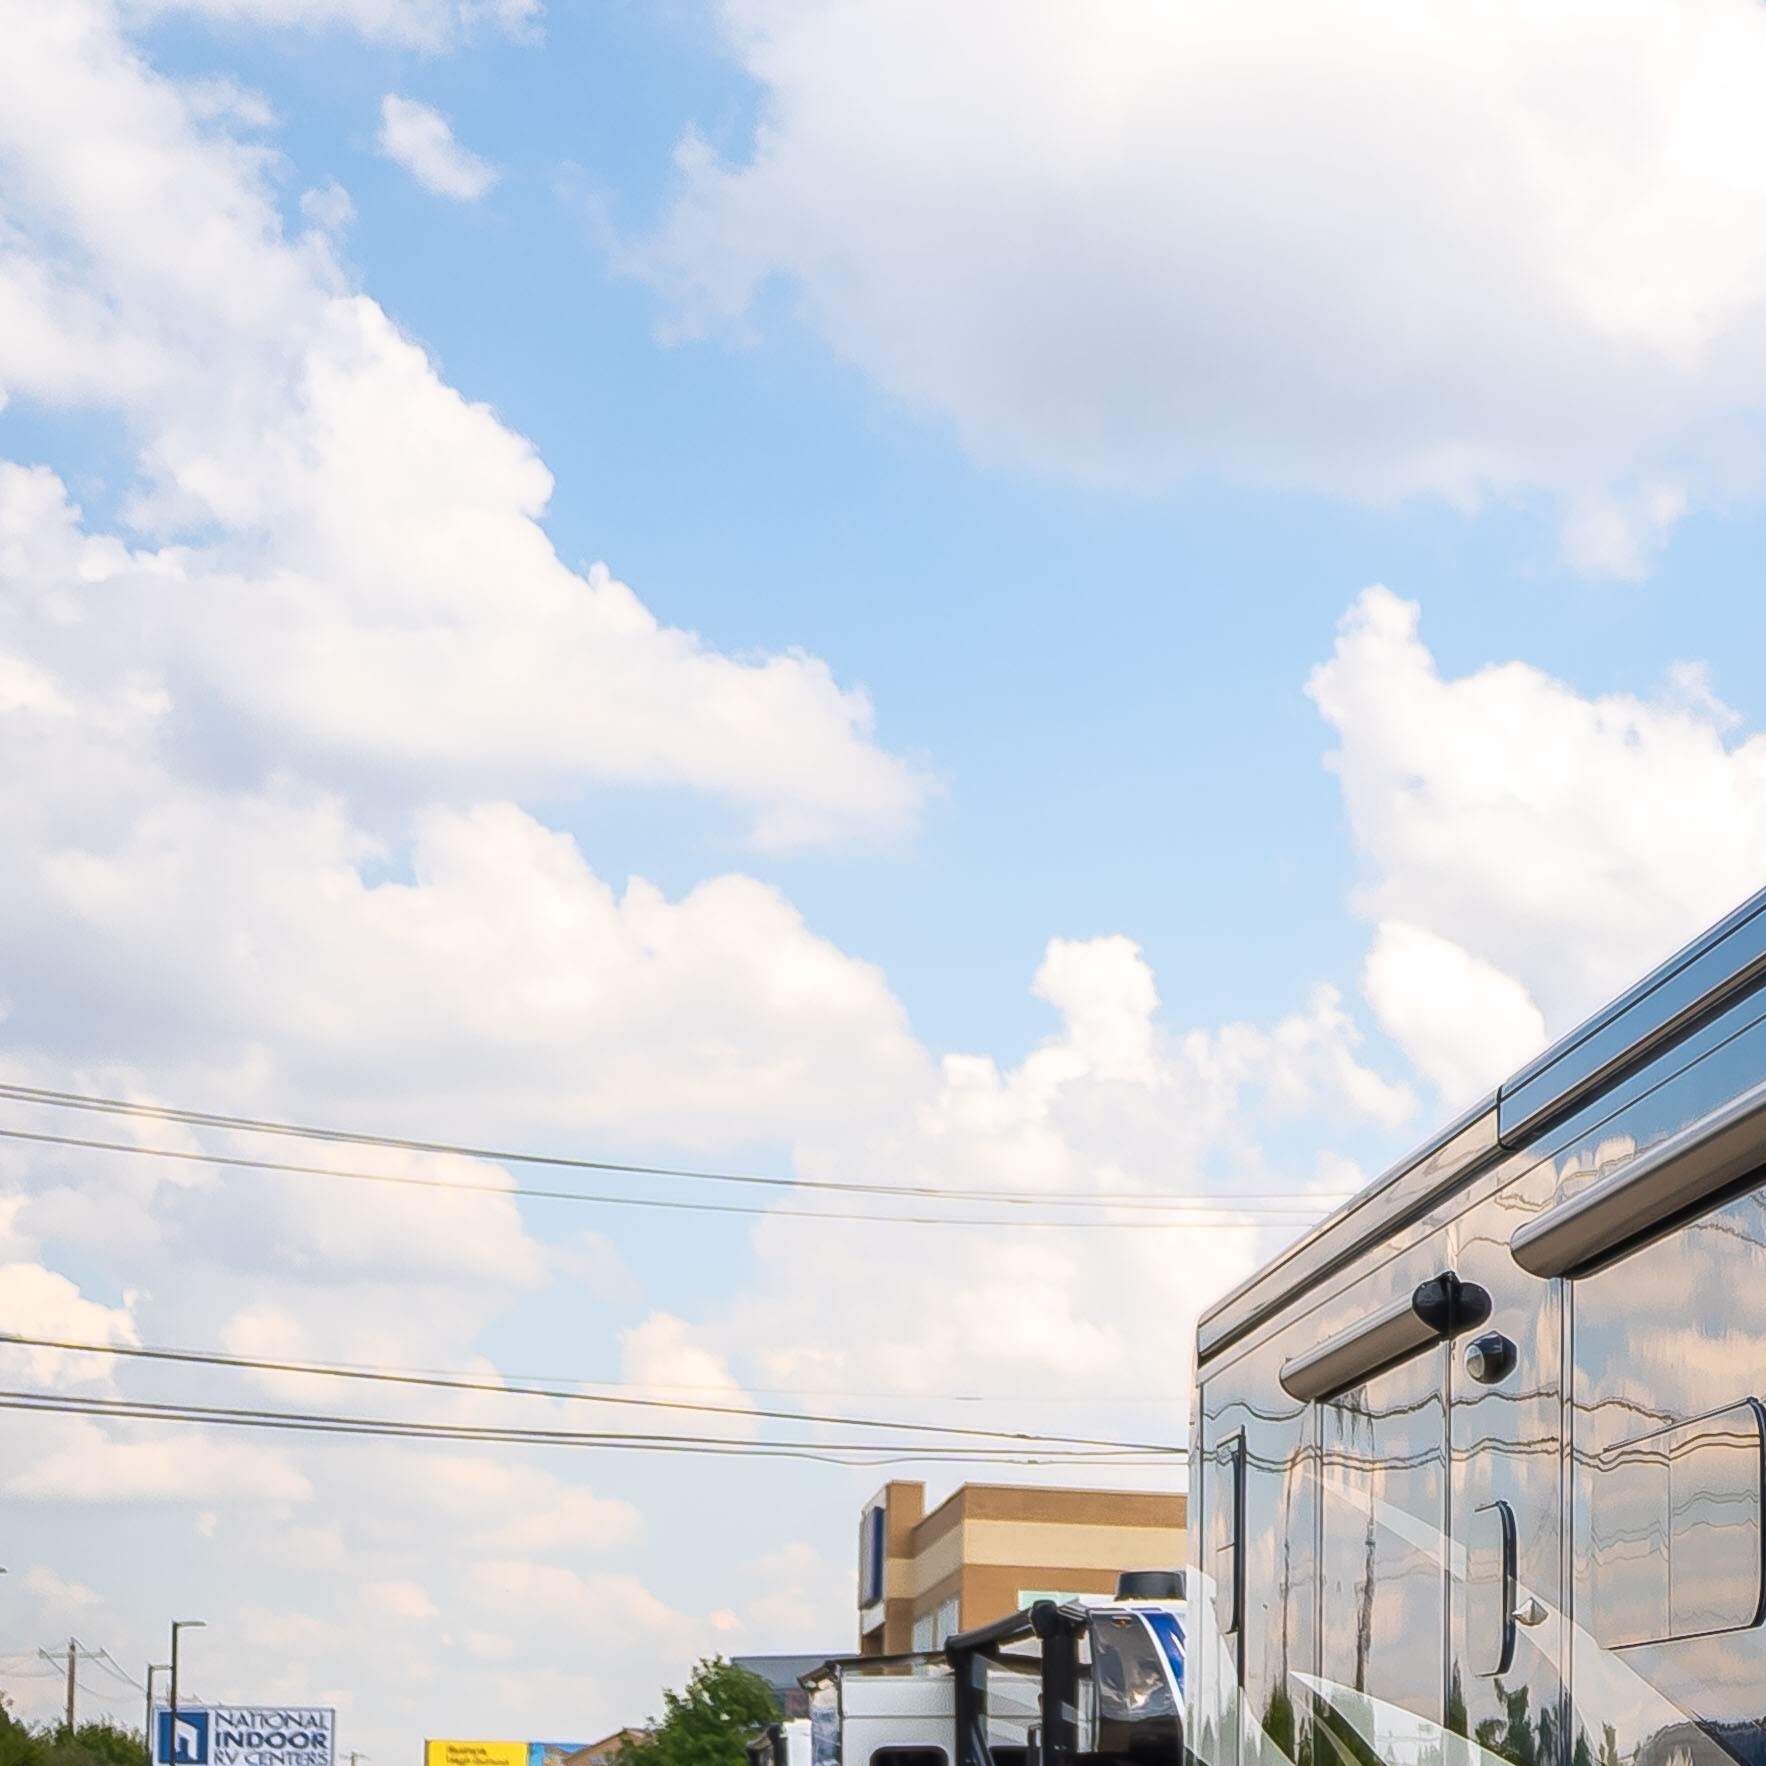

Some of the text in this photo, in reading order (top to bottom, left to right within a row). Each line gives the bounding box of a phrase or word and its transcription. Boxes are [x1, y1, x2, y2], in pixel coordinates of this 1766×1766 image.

[215, 1711, 329, 1730] NATIONAL
[215, 1731, 328, 1749] INDOOR
[214, 1750, 329, 1766] RV CENTERS
